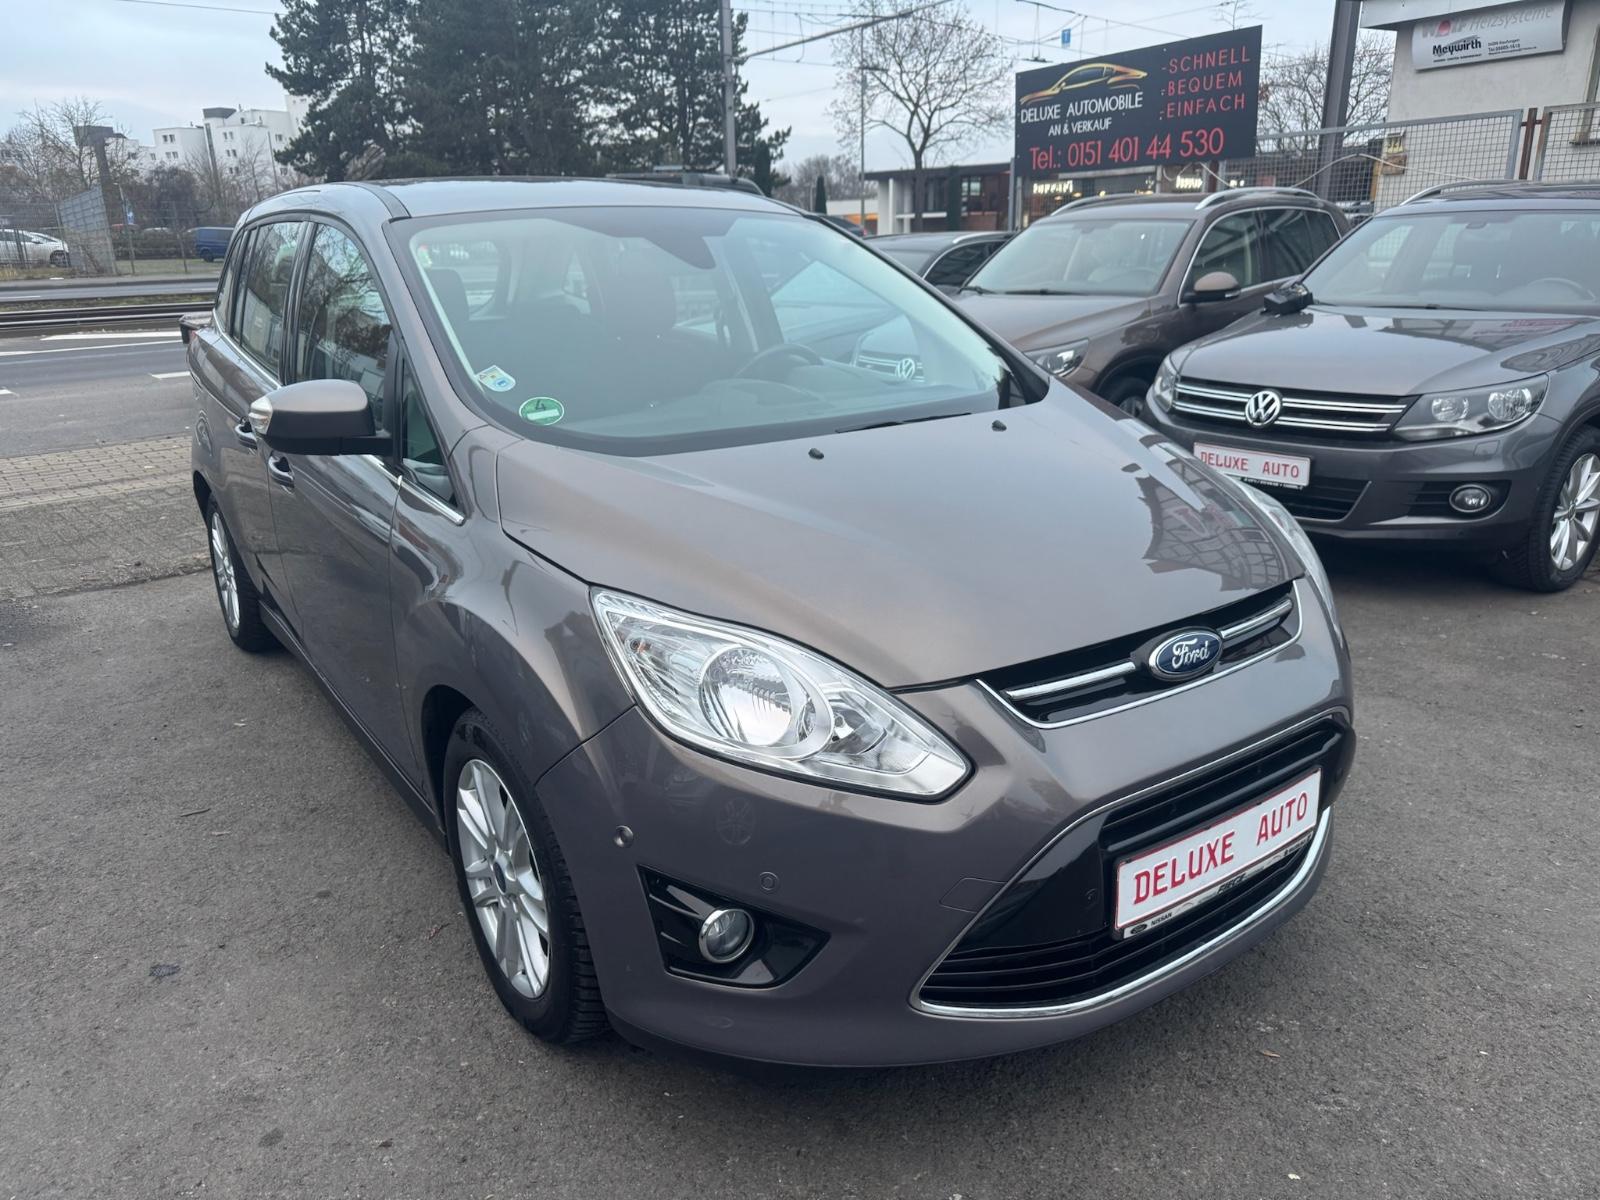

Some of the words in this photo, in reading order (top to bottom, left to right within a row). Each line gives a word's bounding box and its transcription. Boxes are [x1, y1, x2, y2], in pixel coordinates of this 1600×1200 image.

[1432, 38, 1482, 55] Meywirth
[1020, 104, 1061, 124] DELUXE
[1066, 91, 1144, 118] AUTOMOBILE
[1048, 123, 1062, 137] AN
[1062, 121, 1069, 135] &
[1071, 117, 1113, 134] VERKAUF
[1067, 140, 1102, 168] 0151
[1108, 136, 1139, 163] 401
[1145, 133, 1172, 160] 44
[1180, 127, 1225, 158] 530
[1200, 451, 1249, 472] DELUXE
[1262, 461, 1300, 479] AUTO
[1171, 637, 1211, 670] Ford
[1133, 830, 1236, 905] DELUXE
[1256, 791, 1309, 847] AUTO
[1150, 911, 1173, 927] NISSAN
